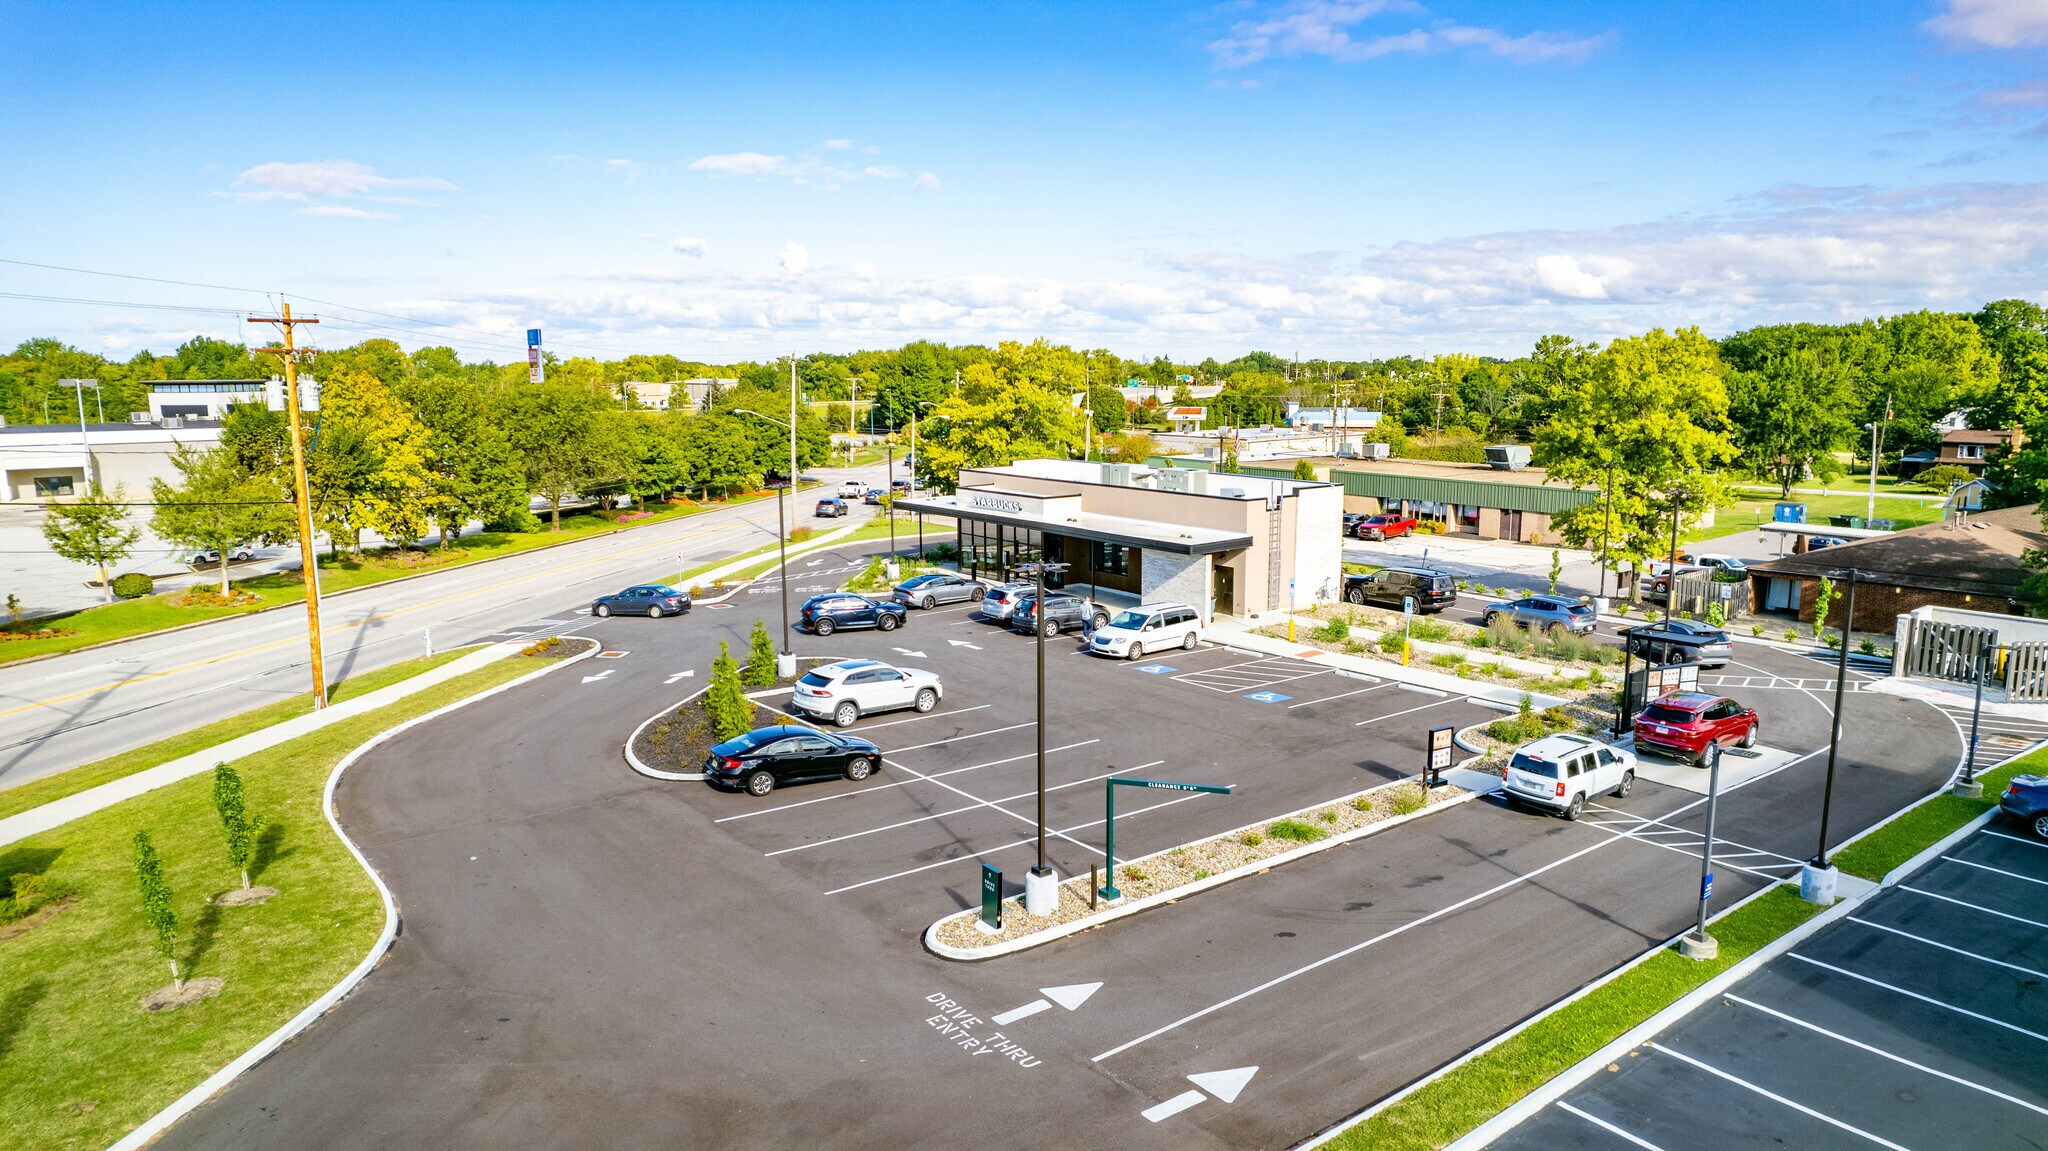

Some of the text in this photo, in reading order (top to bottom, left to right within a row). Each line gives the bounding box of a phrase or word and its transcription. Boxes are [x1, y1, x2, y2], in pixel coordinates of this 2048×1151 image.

[972, 496, 1020, 511] STARBUCKS
[1148, 782, 1180, 790] CLEARANCE
[925, 992, 1043, 1068] DRIVE THRU
[925, 1014, 994, 1056] ENTRY
